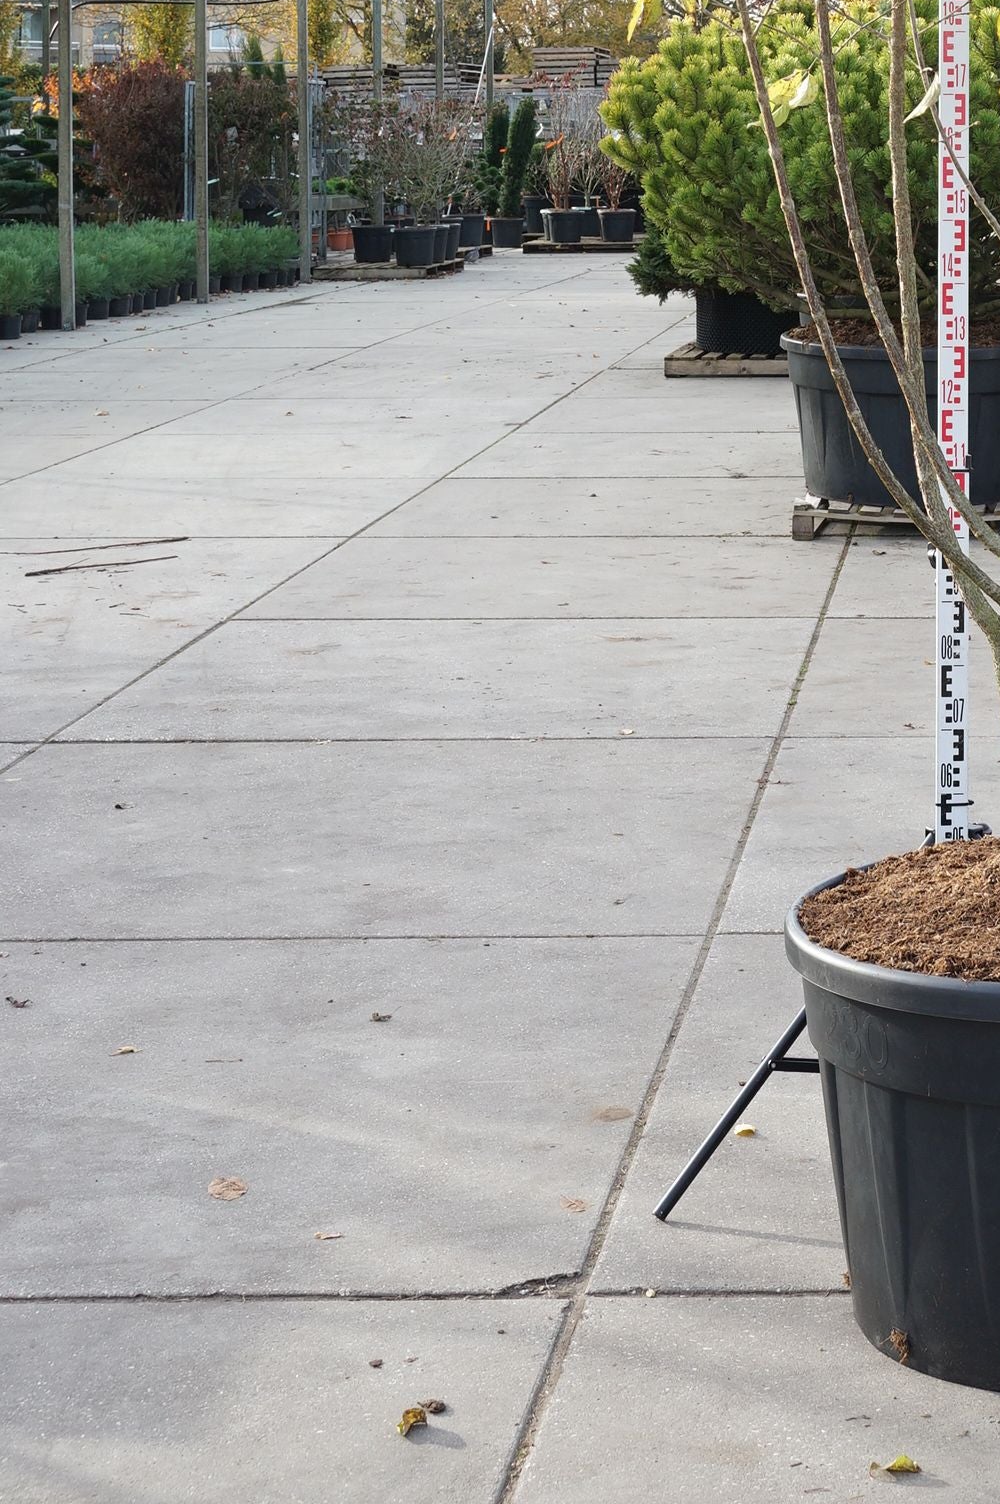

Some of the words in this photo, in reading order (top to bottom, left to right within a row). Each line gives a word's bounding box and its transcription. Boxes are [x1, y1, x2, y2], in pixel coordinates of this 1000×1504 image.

[954, 64, 966, 87] 17
[954, 189, 966, 214] 15
[942, 253, 953, 277] 14
[954, 316, 965, 341] 13
[941, 379, 953, 404] 12
[954, 443, 965, 467] 11
[941, 634, 952, 659] 08
[953, 698, 965, 723] 07
[941, 763, 952, 788] 06
